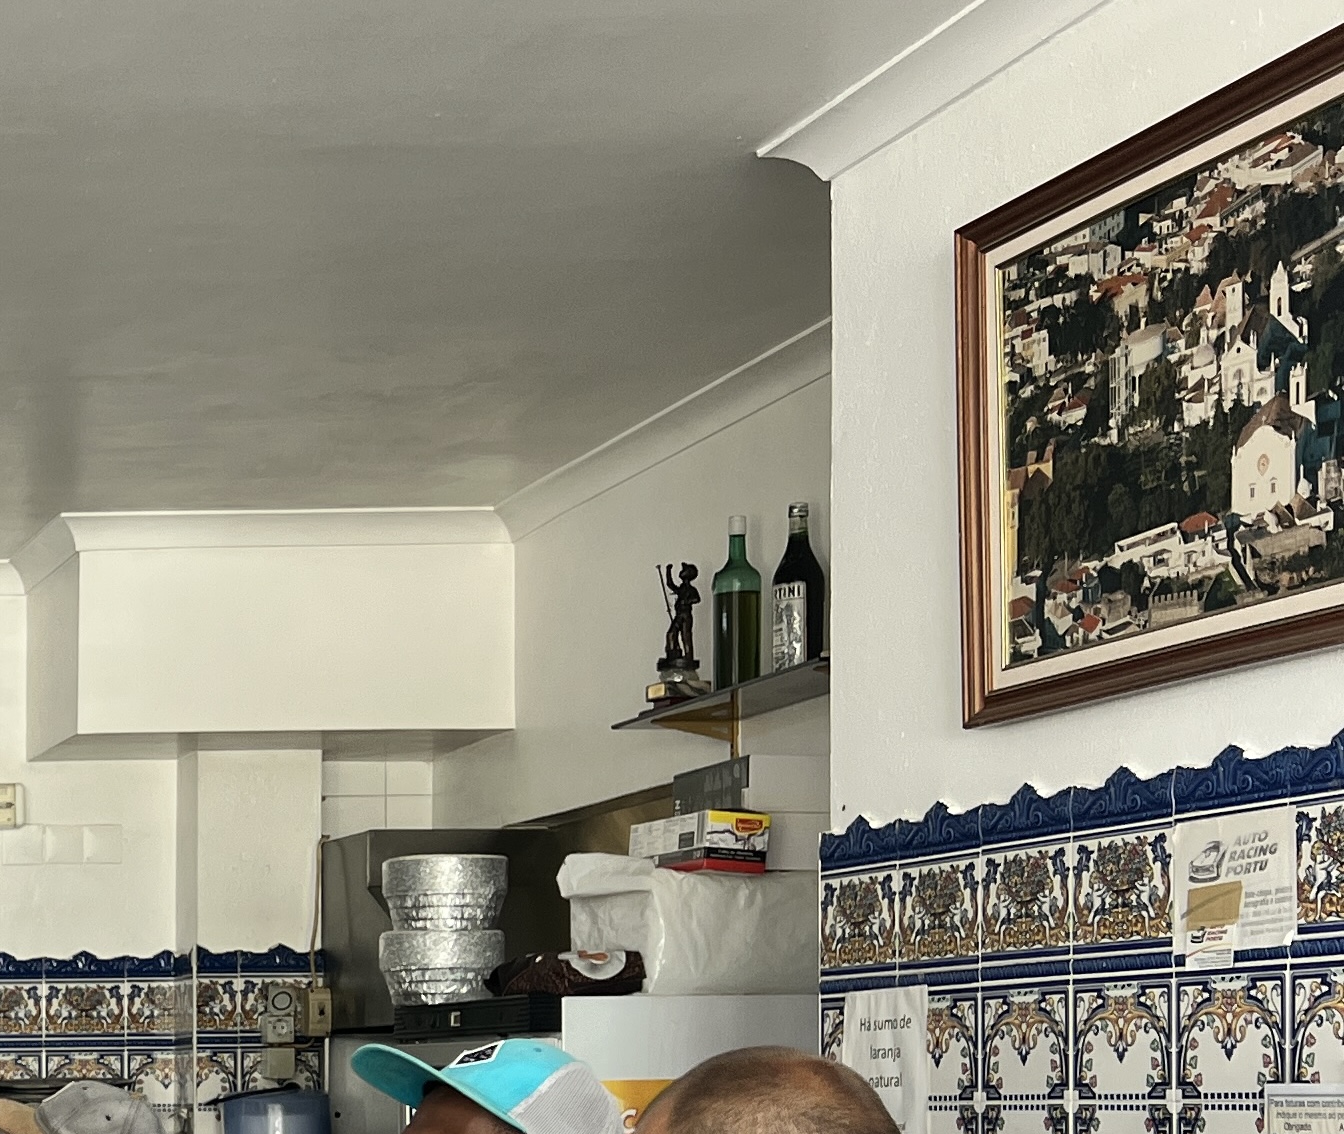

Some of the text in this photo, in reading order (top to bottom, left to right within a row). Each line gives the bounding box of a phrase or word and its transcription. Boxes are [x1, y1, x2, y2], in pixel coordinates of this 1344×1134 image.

[1233, 830, 1269, 847] AUTO
[1227, 842, 1278, 863] RACING
[1225, 858, 1269, 877] PORTU
[859, 1014, 912, 1032] Há sumo de
[869, 1046, 901, 1063] laranja
[868, 1073, 903, 1088] natural
